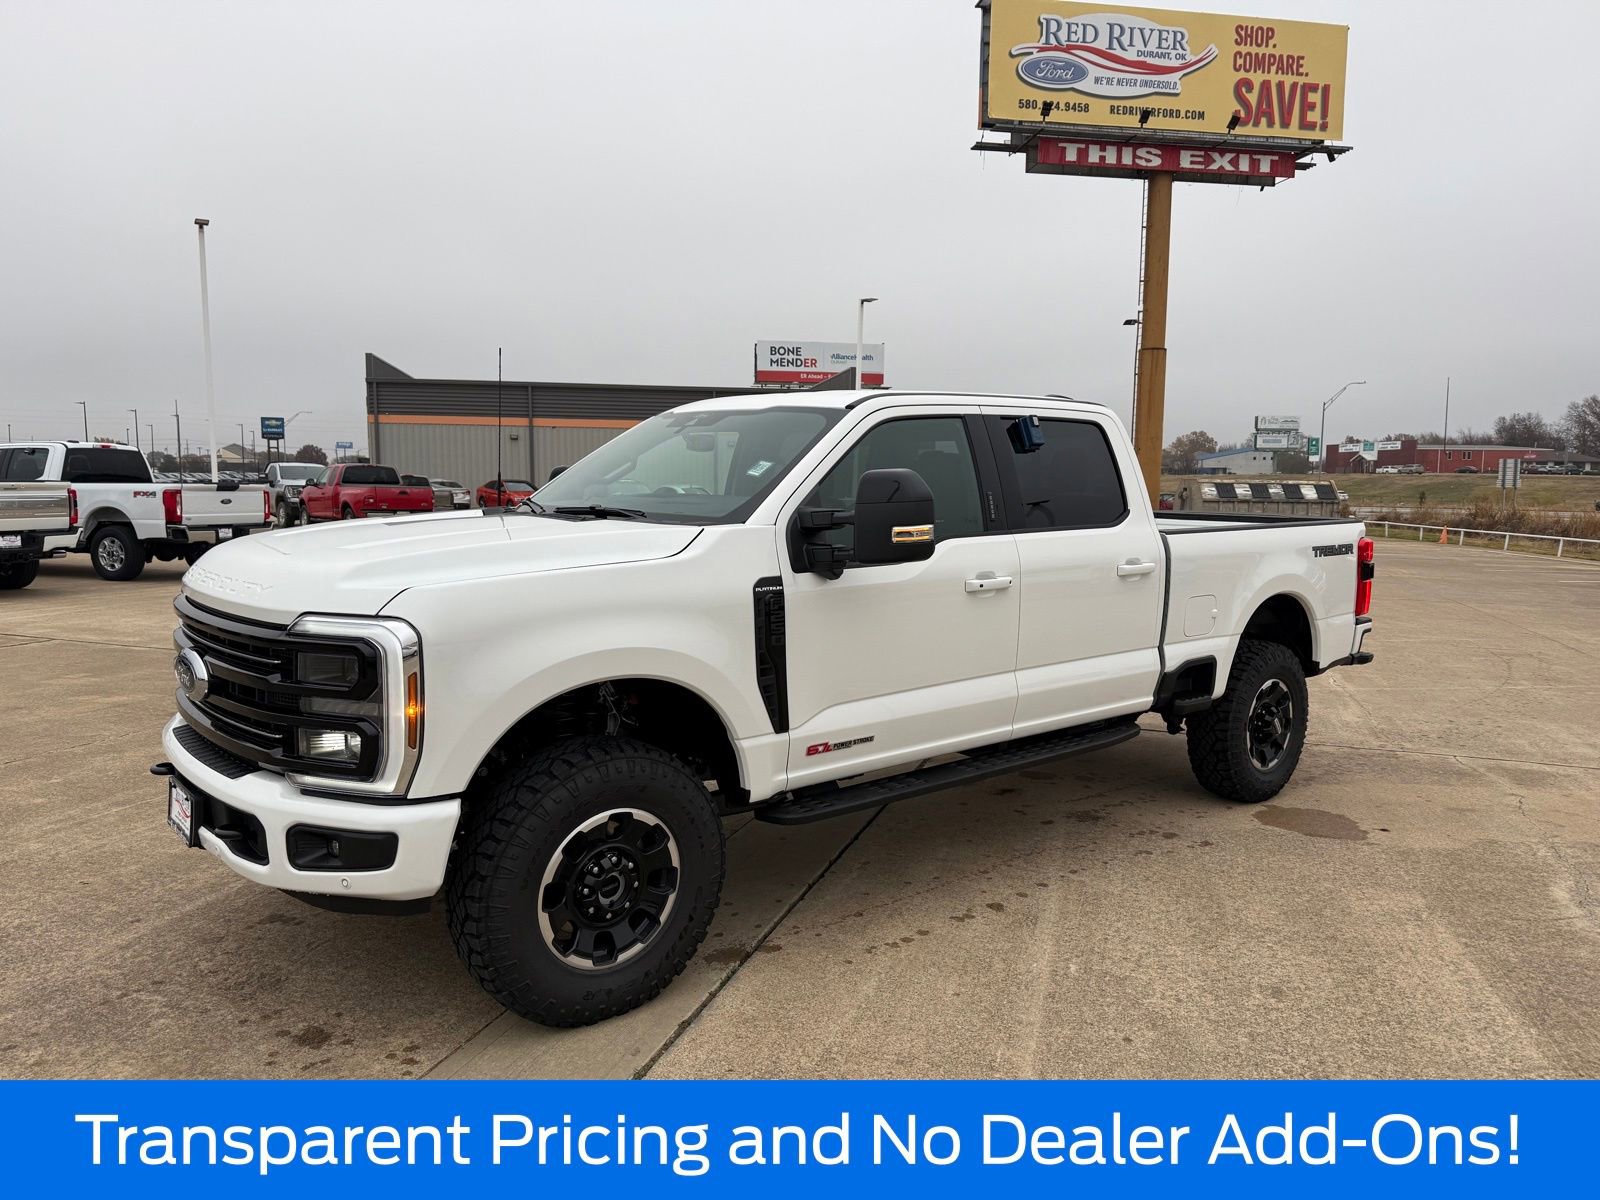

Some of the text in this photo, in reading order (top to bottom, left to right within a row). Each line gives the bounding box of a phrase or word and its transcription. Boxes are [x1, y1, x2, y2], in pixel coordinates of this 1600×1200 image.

[1042, 17, 1188, 51] RED RIVER
[1234, 24, 1277, 49] SHOP.
[1136, 49, 1188, 61] DURANT, OK
[1036, 61, 1074, 79] Ford
[1233, 51, 1309, 77] COMPARE.
[1094, 76, 1179, 90] WE'RE NEVER UNDERSOLD.
[1018, 99, 1090, 113] 580.4.9458
[1233, 77, 1331, 131] SAVE!
[1058, 142, 1279, 173] THIS EXIT
[770, 346, 802, 357] BONE
[770, 358, 817, 368] MENDER
[1311, 544, 1354, 557] TREMOR
[833, 740, 852, 751] POWER
[852, 735, 875, 746] STROKE
